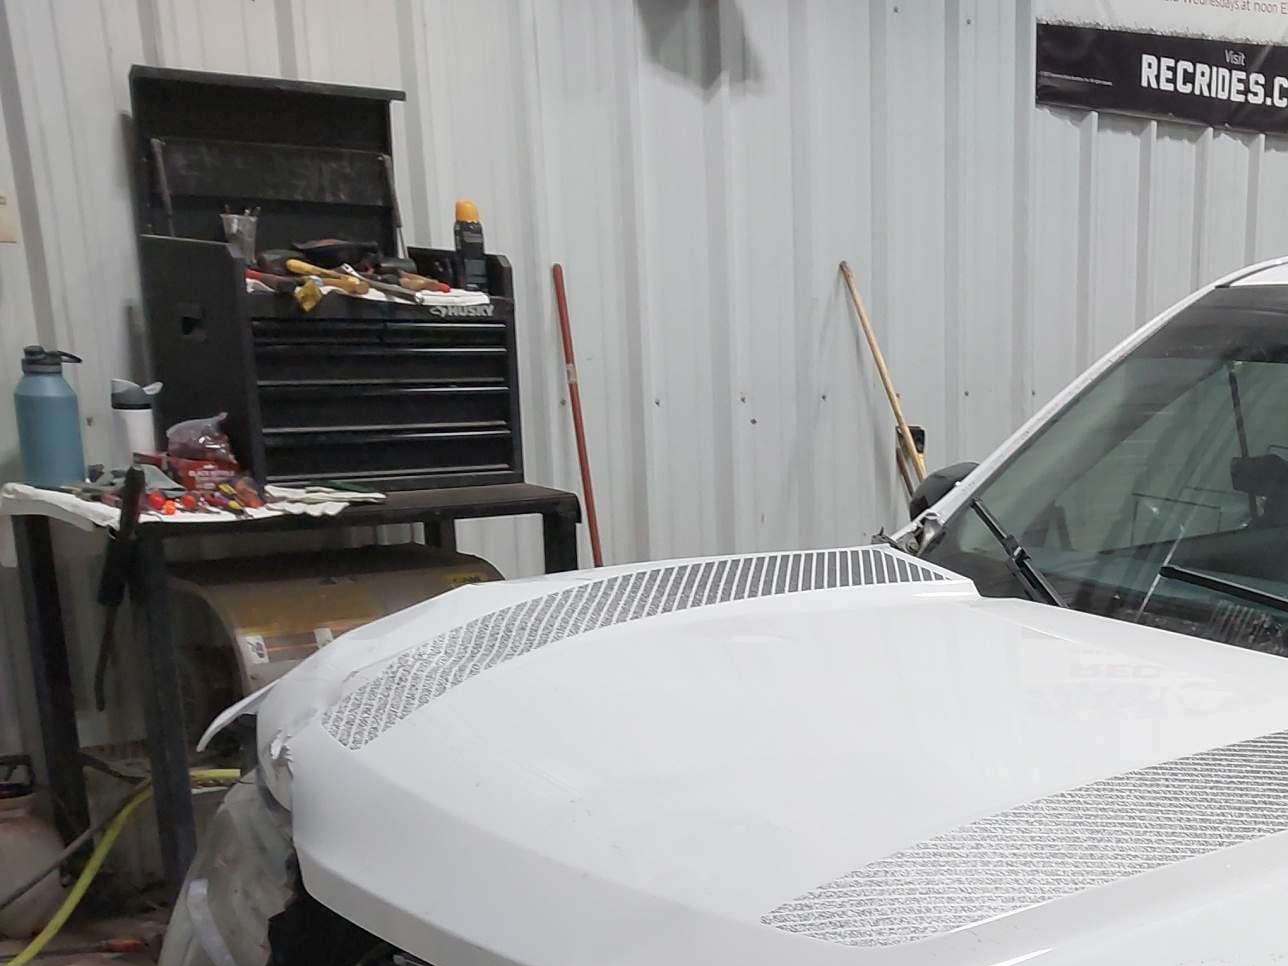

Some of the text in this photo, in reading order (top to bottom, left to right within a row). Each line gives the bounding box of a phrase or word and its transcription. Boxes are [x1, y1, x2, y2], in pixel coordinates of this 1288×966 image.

[1253, 3, 1279, 15] noon
[1224, 49, 1246, 66] Visit
[447, 304, 495, 317] HUSKY
